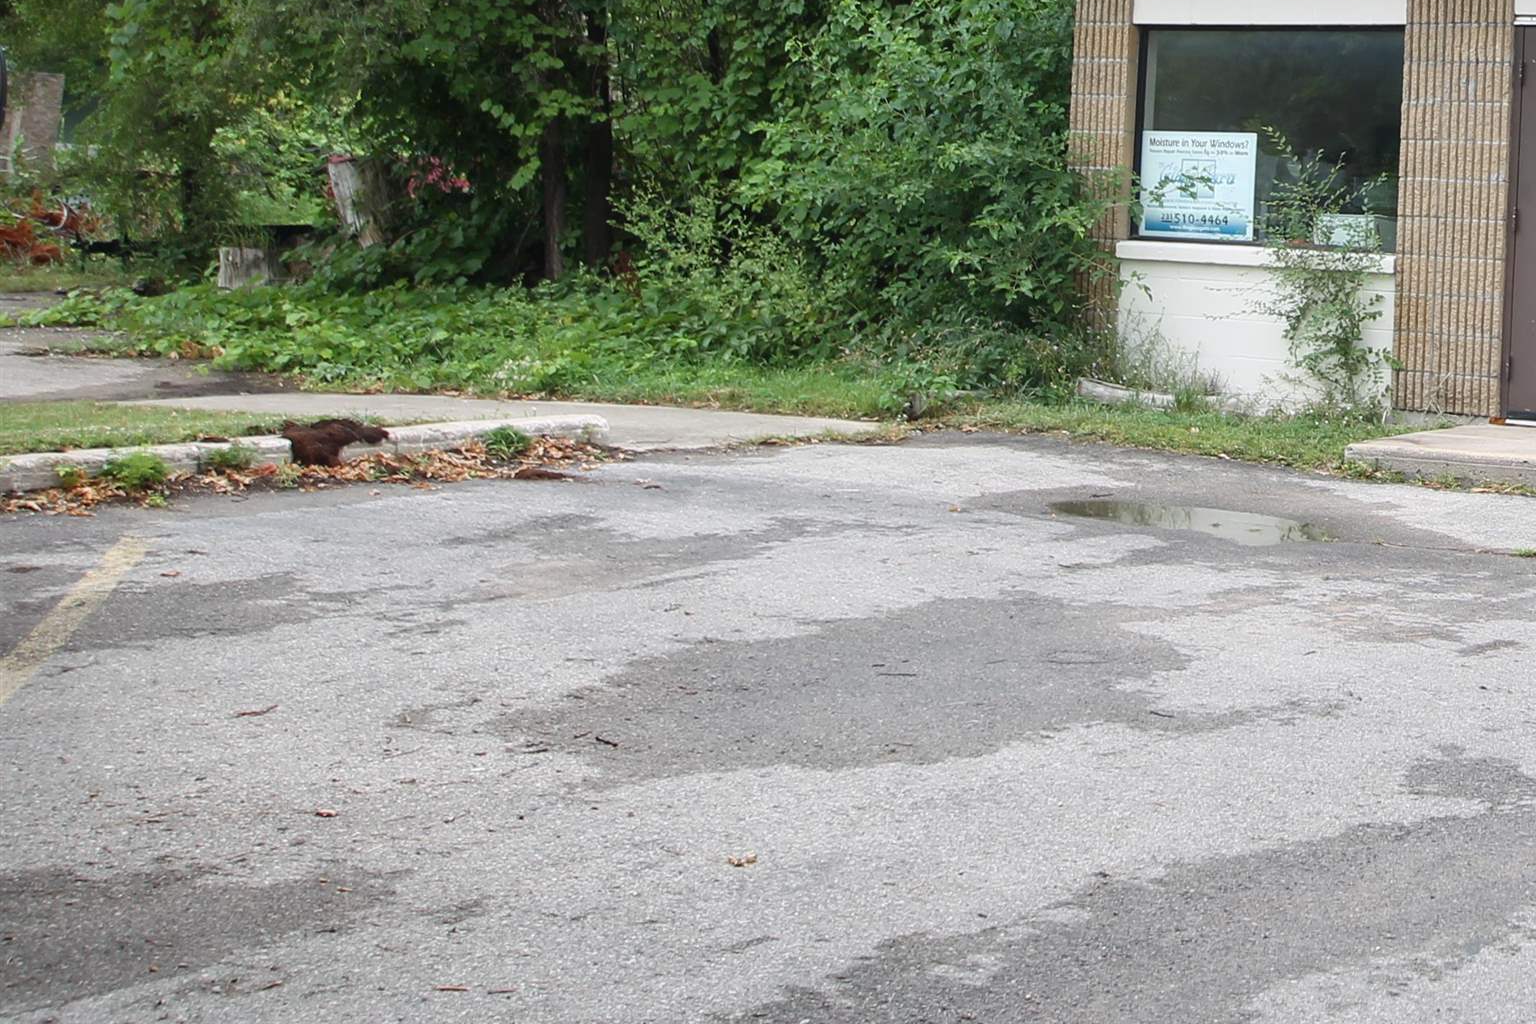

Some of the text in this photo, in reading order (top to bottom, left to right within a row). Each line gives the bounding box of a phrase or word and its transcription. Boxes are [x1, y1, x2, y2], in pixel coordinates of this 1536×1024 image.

[1149, 137, 1249, 149] Moisture in Your Windows?
[1174, 213, 1229, 225] 510-4464
